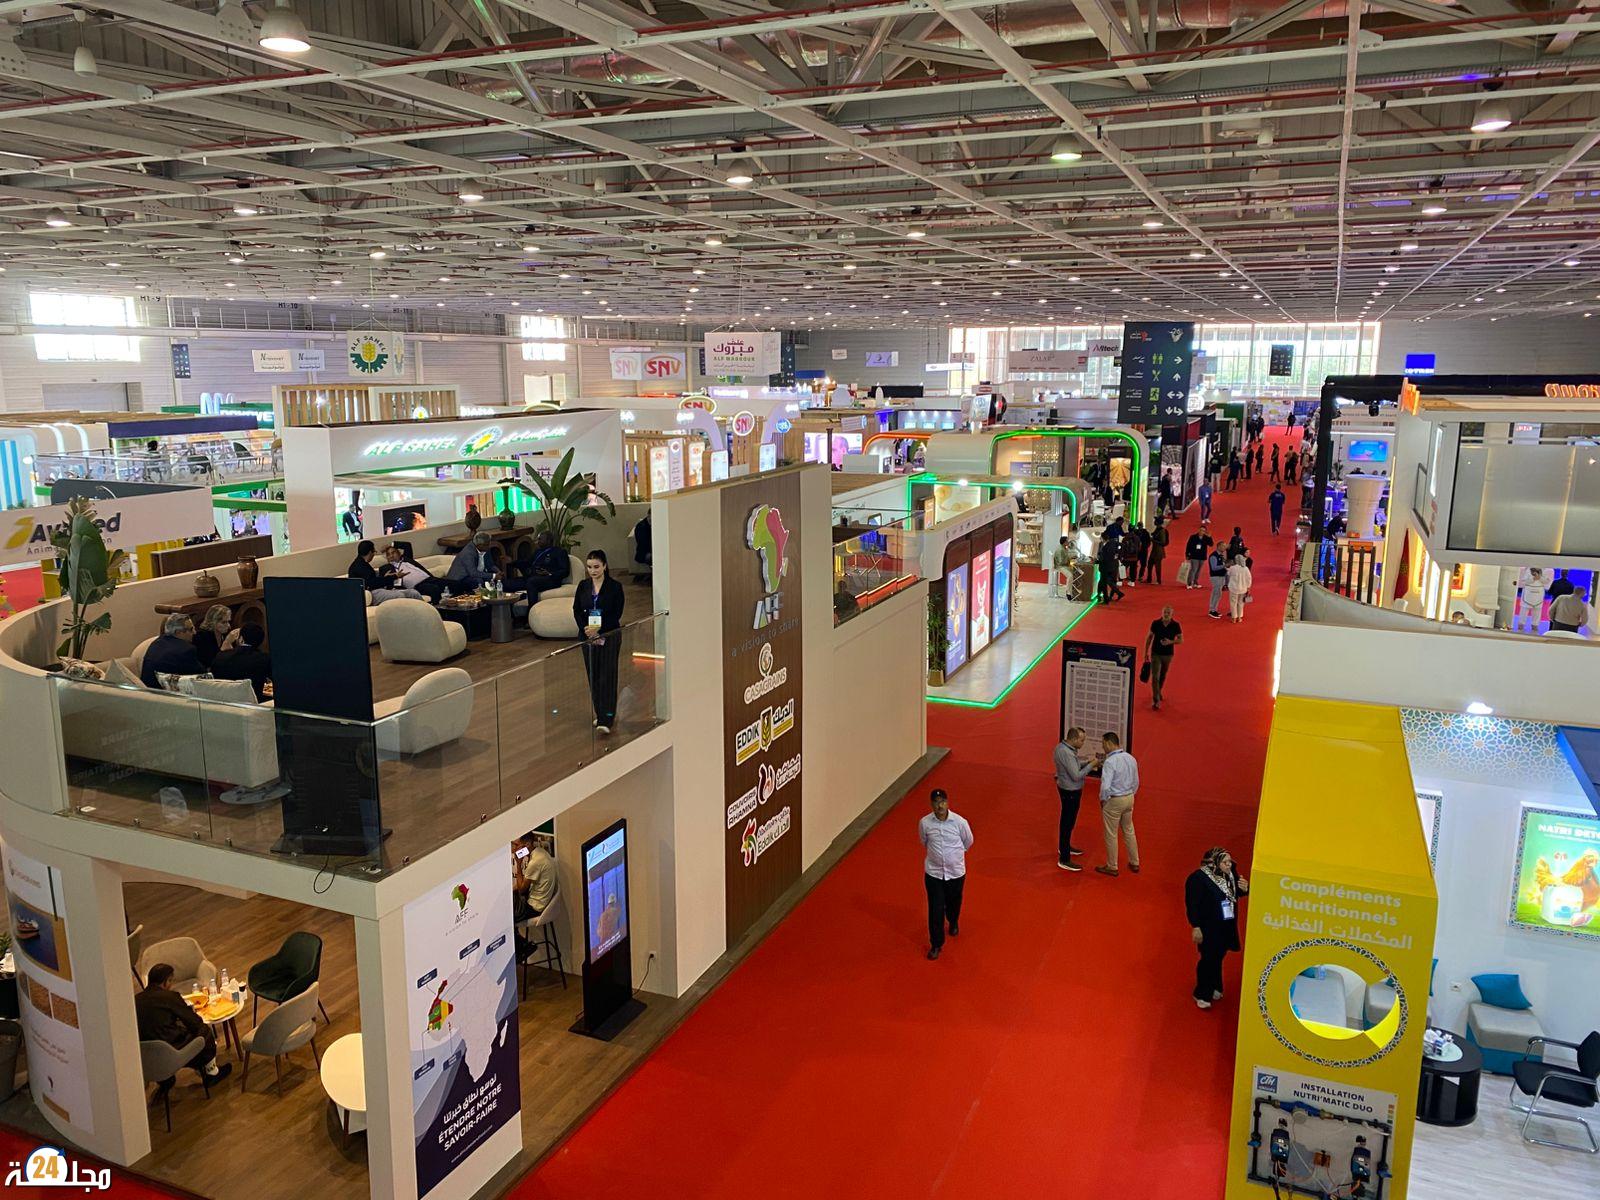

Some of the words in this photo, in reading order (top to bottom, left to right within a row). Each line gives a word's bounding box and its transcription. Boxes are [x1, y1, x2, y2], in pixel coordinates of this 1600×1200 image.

[351, 338, 361, 351] ALF
[364, 335, 387, 352] SAHEL
[713, 344, 754, 356] مبروك
[615, 359, 637, 376] SNV
[646, 359, 682, 377] SNV
[744, 668, 786, 703] CASAGRAINS
[773, 701, 793, 725] الديك
[737, 722, 760, 749] EDDIK
[729, 789, 757, 815] COUVOIRS
[729, 801, 756, 825] RHAMNA
[1279, 876, 1402, 908] Compléments
[1262, 911, 1324, 935] الغذائية
[1280, 895, 1398, 927] Nutritionnels
[1329, 925, 1413, 950] المكملات
[1293, 1090, 1351, 1109] NUTRI'MATIC
[1352, 1102, 1373, 1113] DUO
[1301, 1082, 1365, 1102] INSTALLATION
[438, 1105, 476, 1144] ÉTENDRE
[476, 1082, 502, 1111] NOTRE
[444, 1098, 498, 1151] SAVOIR-FAIRE
